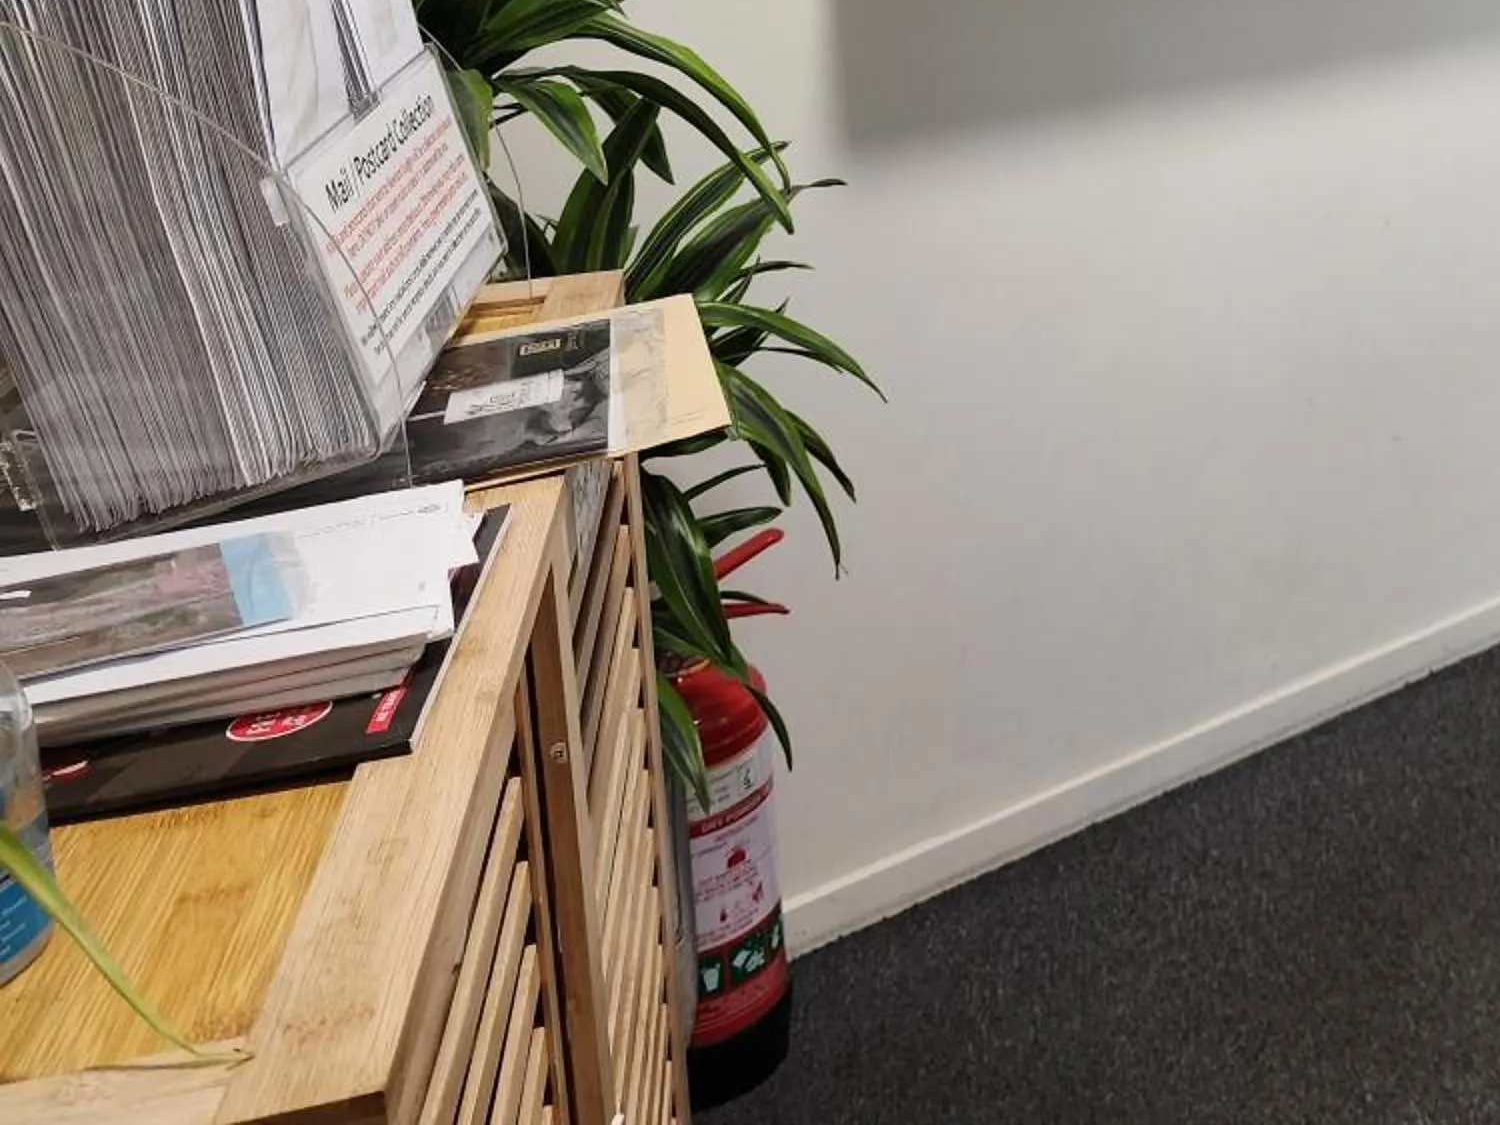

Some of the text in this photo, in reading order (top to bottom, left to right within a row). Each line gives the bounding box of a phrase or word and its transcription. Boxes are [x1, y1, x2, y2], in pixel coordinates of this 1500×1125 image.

[325, 167, 355, 214] Mail
[353, 122, 398, 186] Postcard
[392, 94, 435, 145] Collection
